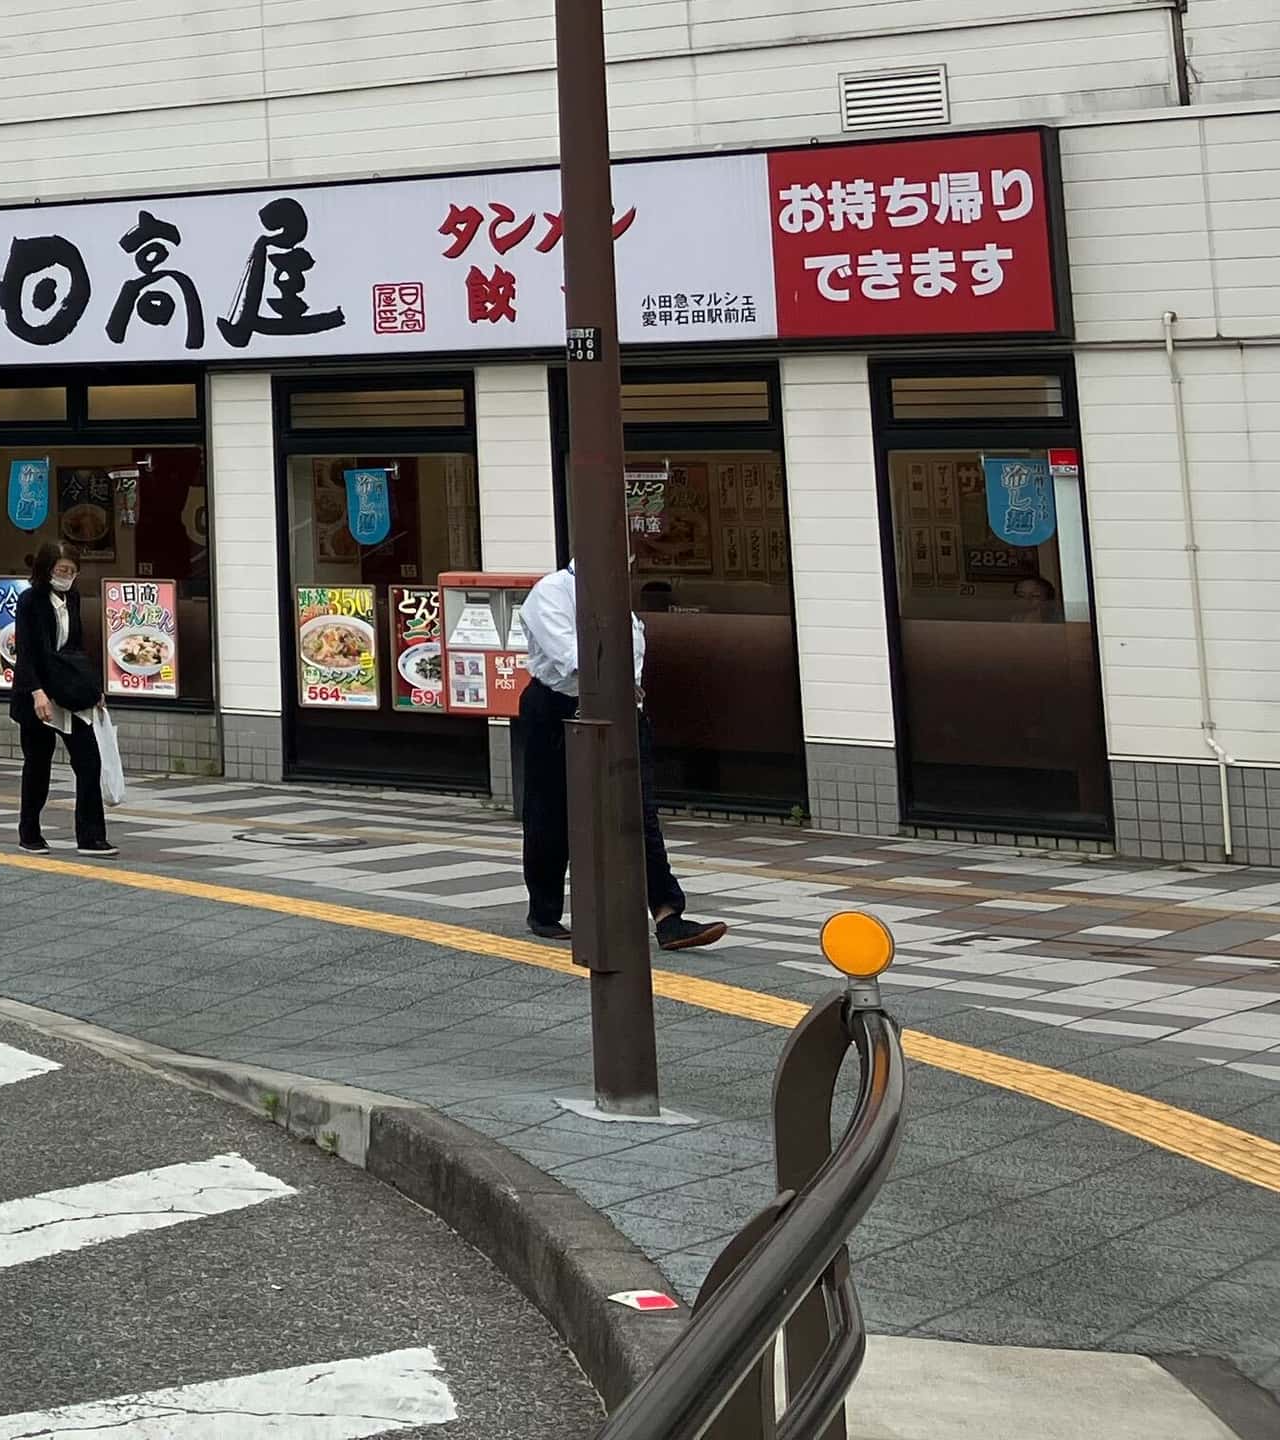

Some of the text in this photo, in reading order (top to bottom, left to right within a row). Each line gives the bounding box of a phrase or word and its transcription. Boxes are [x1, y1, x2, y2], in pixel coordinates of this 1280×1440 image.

[777, 168, 1034, 234] お持ち帰り
[804, 242, 1014, 303] できます
[640, 291, 753, 310] 小田急マルシェ
[641, 307, 757, 327] 愛甲石田駅前店
[121, 583, 158, 604] 日高
[495, 678, 516, 690] POST
